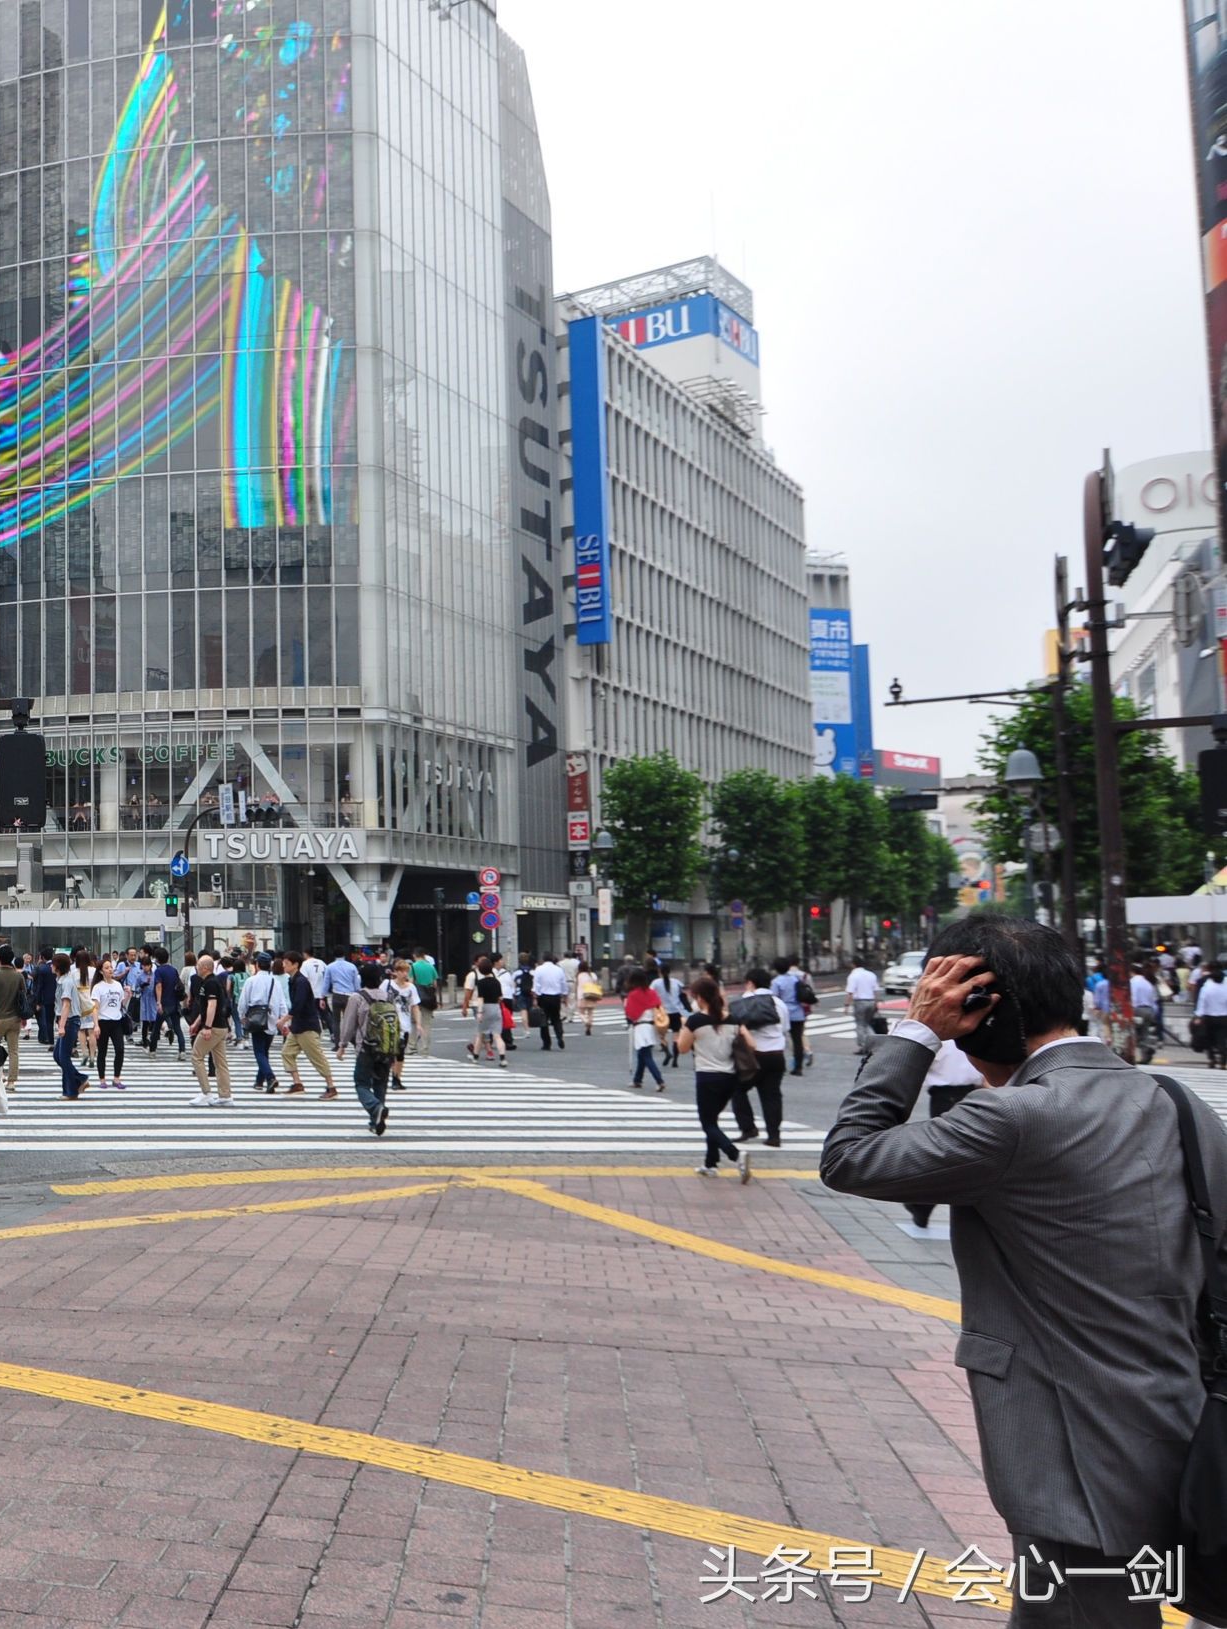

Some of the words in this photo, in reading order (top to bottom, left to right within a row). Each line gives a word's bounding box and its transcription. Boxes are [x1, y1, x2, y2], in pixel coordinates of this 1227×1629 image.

[516, 284, 558, 768] TSUTAYA
[576, 533, 602, 623] SEIBU
[138, 742, 235, 764] COFFEE
[204, 832, 359, 860] TSUTAYA
